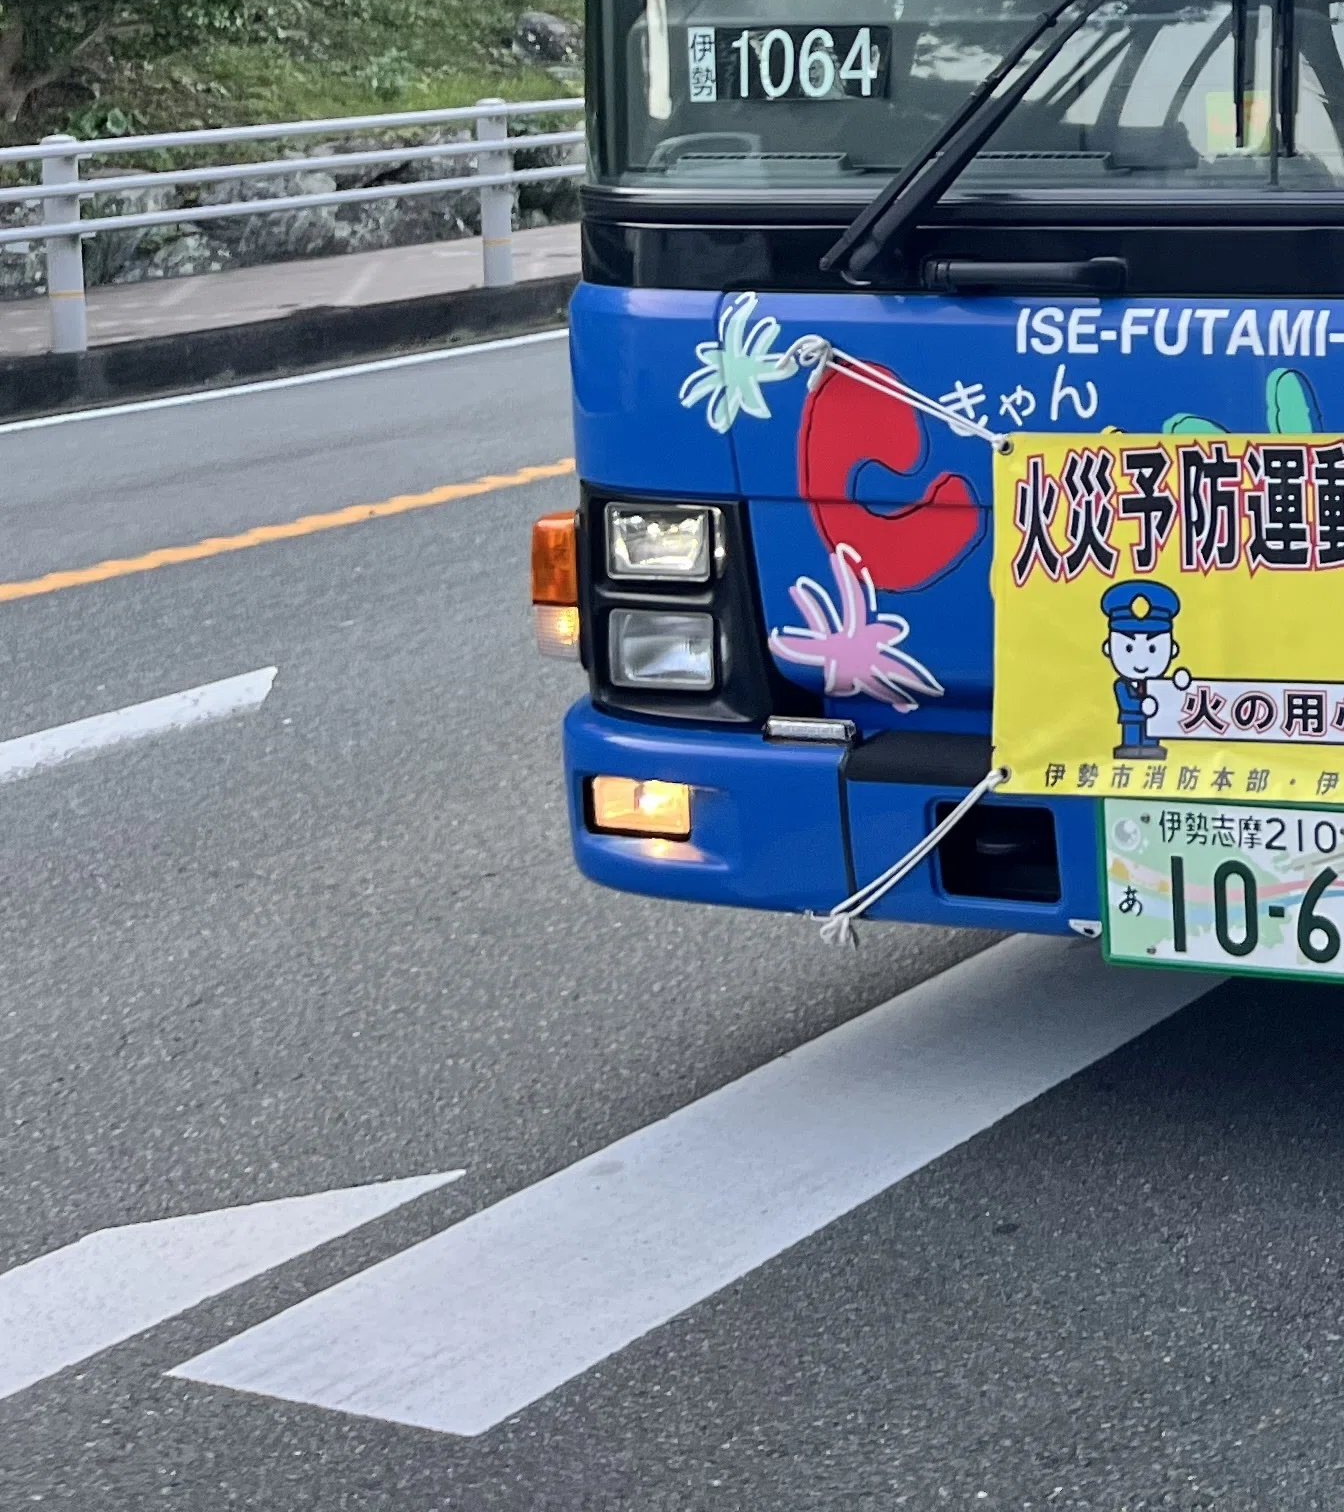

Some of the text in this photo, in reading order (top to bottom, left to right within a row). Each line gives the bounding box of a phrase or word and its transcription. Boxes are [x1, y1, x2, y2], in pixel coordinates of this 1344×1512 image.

[690, 32, 717, 97] 伊勢
[731, 27, 878, 98] 1064
[938, 362, 1099, 437] きゃん
[1117, 885, 1144, 917] あ
